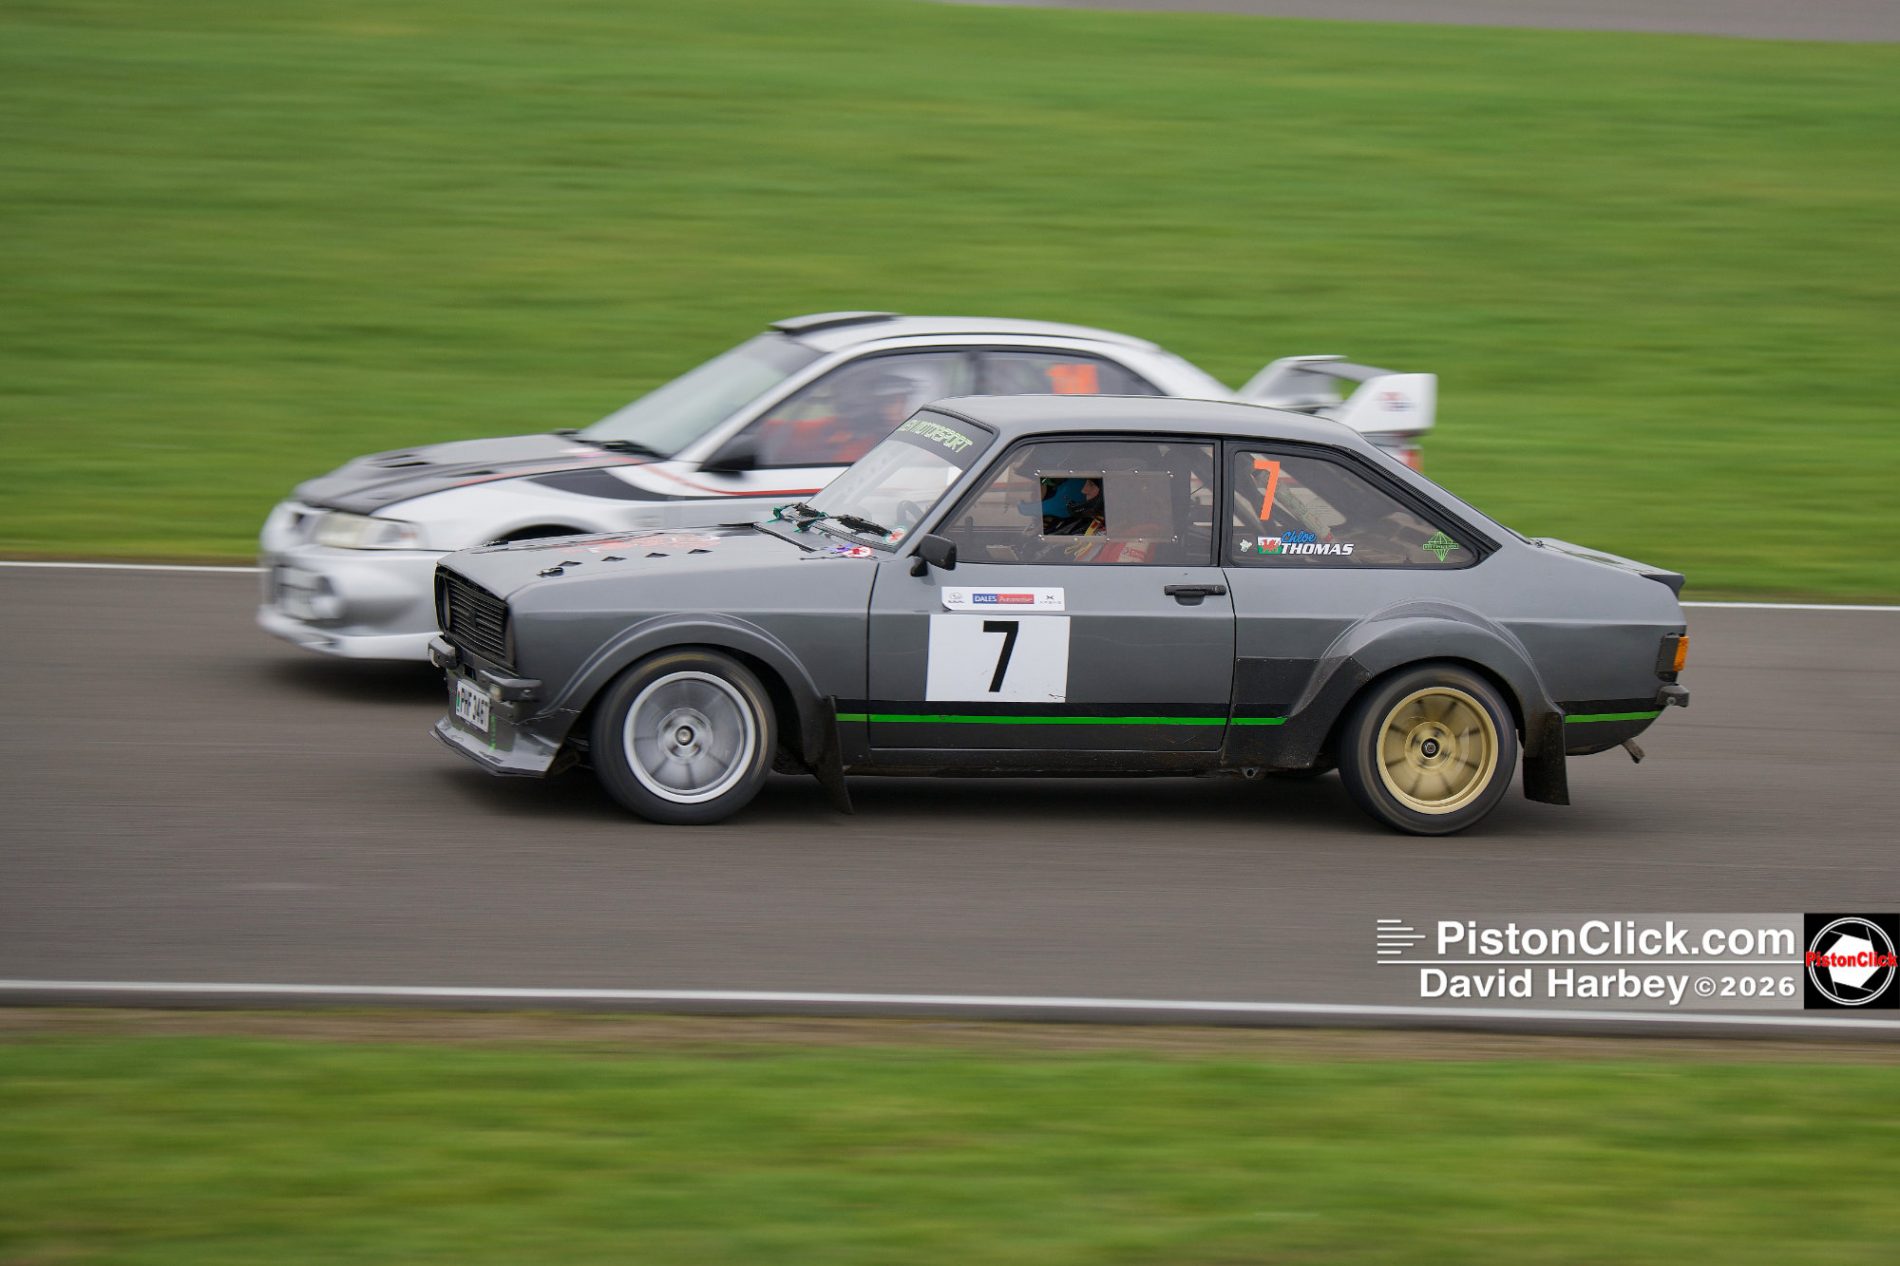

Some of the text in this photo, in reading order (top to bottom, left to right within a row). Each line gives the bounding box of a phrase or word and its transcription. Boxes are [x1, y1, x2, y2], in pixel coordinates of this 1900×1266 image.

[1253, 459, 1281, 521] 7
[1281, 543, 1355, 555] THOMAS
[974, 594, 998, 603] DALES
[983, 620, 1019, 692] 7
